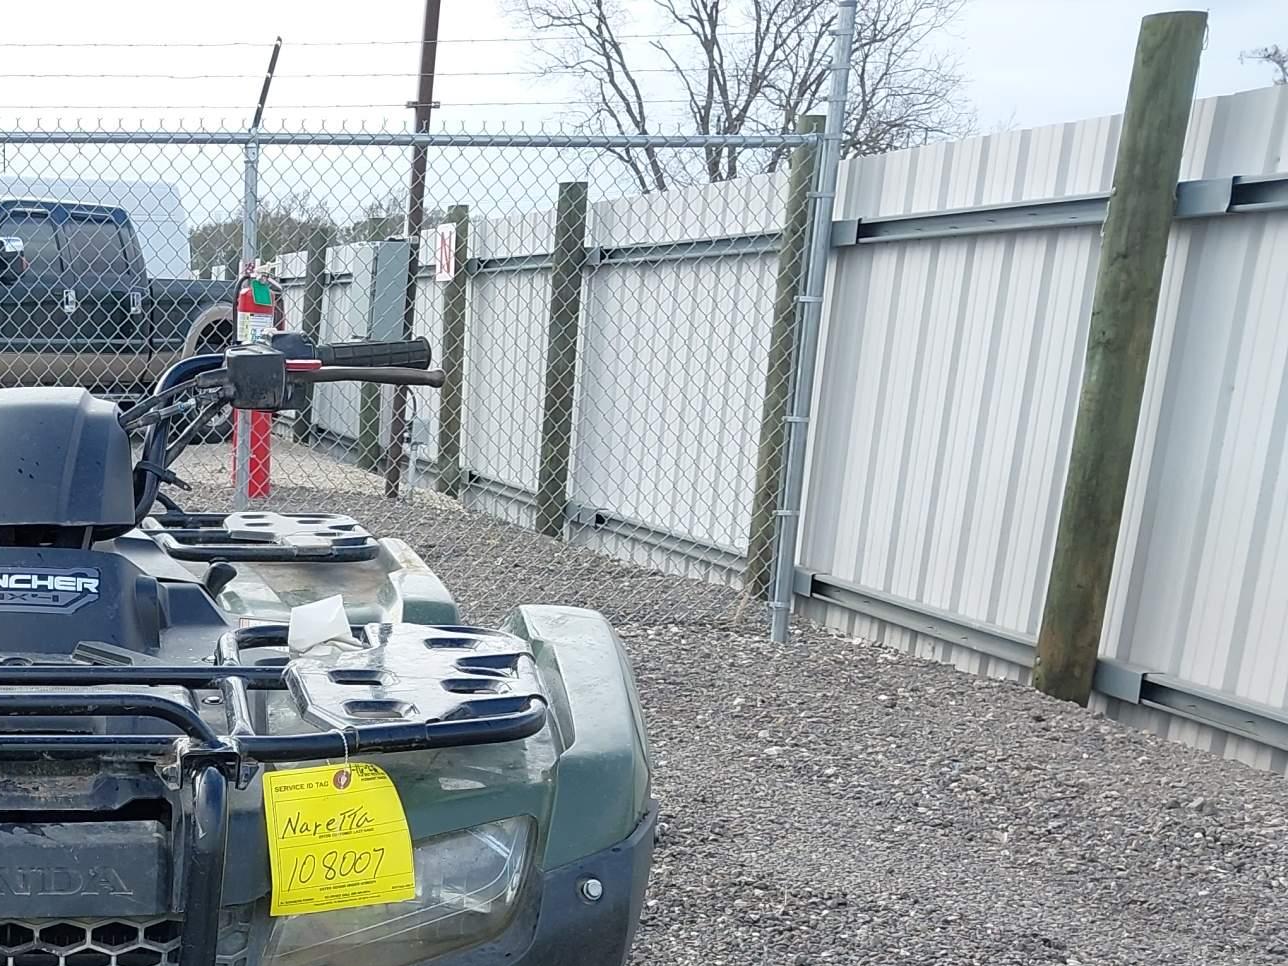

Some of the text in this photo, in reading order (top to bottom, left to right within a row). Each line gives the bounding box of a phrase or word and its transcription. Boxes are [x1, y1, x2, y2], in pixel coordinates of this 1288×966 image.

[274, 781, 329, 793] SERVICE ID TAG
